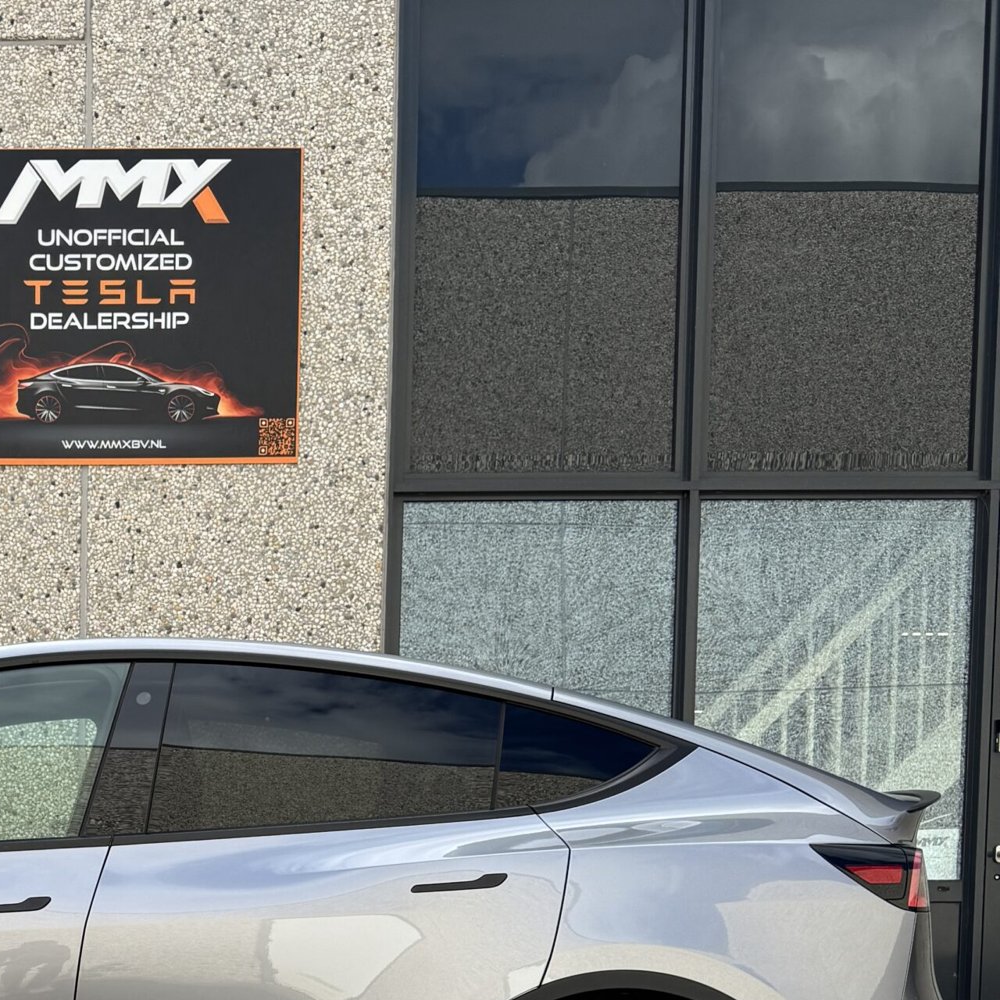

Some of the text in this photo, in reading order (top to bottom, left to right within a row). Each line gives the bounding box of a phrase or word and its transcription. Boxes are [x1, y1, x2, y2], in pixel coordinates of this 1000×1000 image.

[37, 228, 184, 247] UNOFFICIAL
[29, 253, 193, 272] CUSTOMIZED
[23, 279, 196, 305] TESLA
[30, 312, 190, 330] DEALERSHIP
[61, 439, 167, 450] WWW.MMXBV.NL
